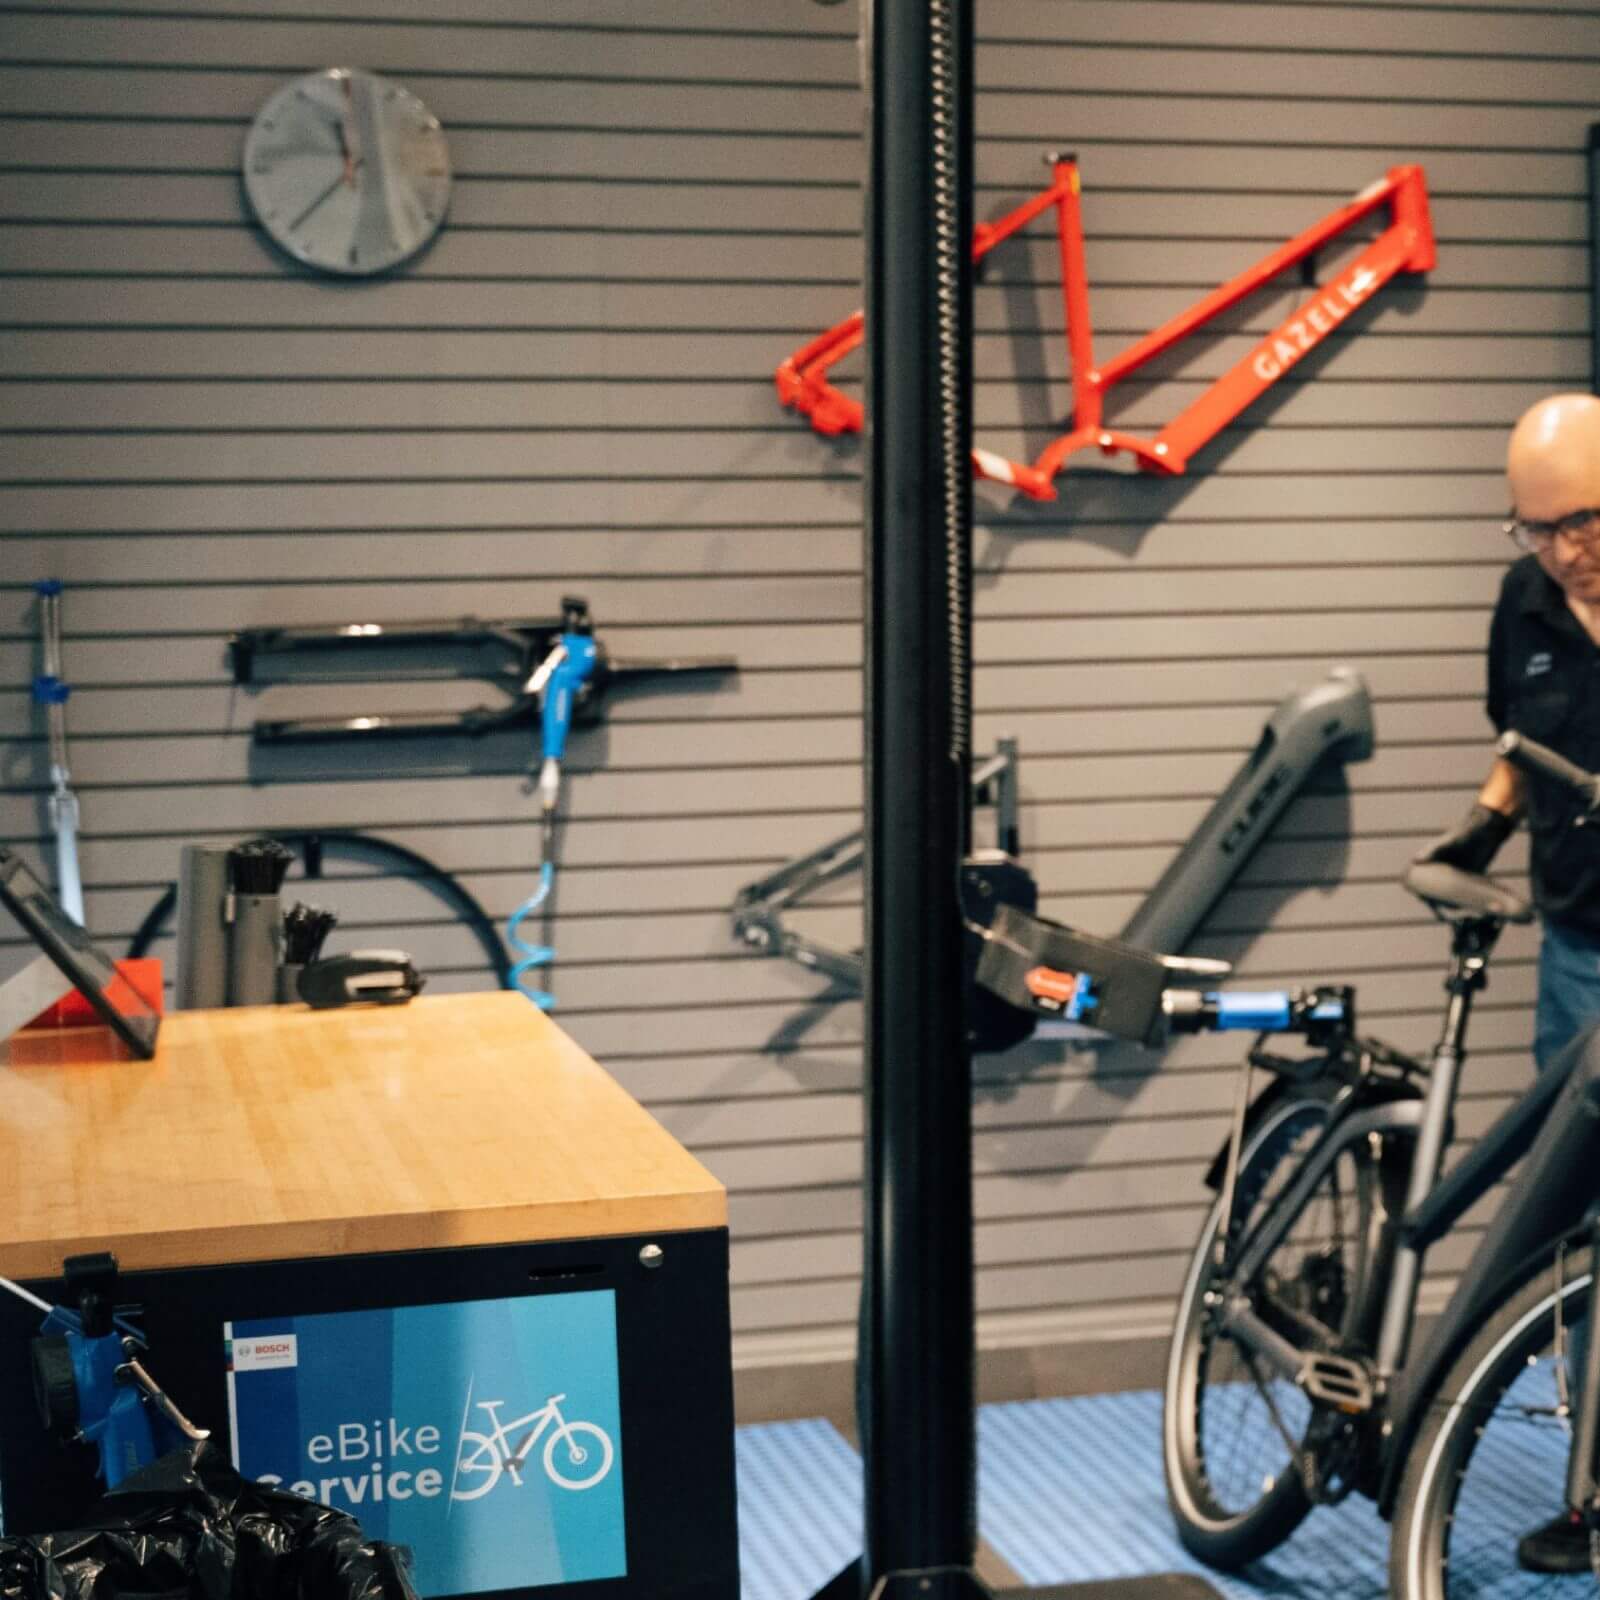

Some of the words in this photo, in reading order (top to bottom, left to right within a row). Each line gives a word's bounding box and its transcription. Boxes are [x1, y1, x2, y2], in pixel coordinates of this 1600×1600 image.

[255, 1343, 290, 1354] BOSCH
[308, 1418, 440, 1463] eBike
[256, 1462, 443, 1506] ervice
